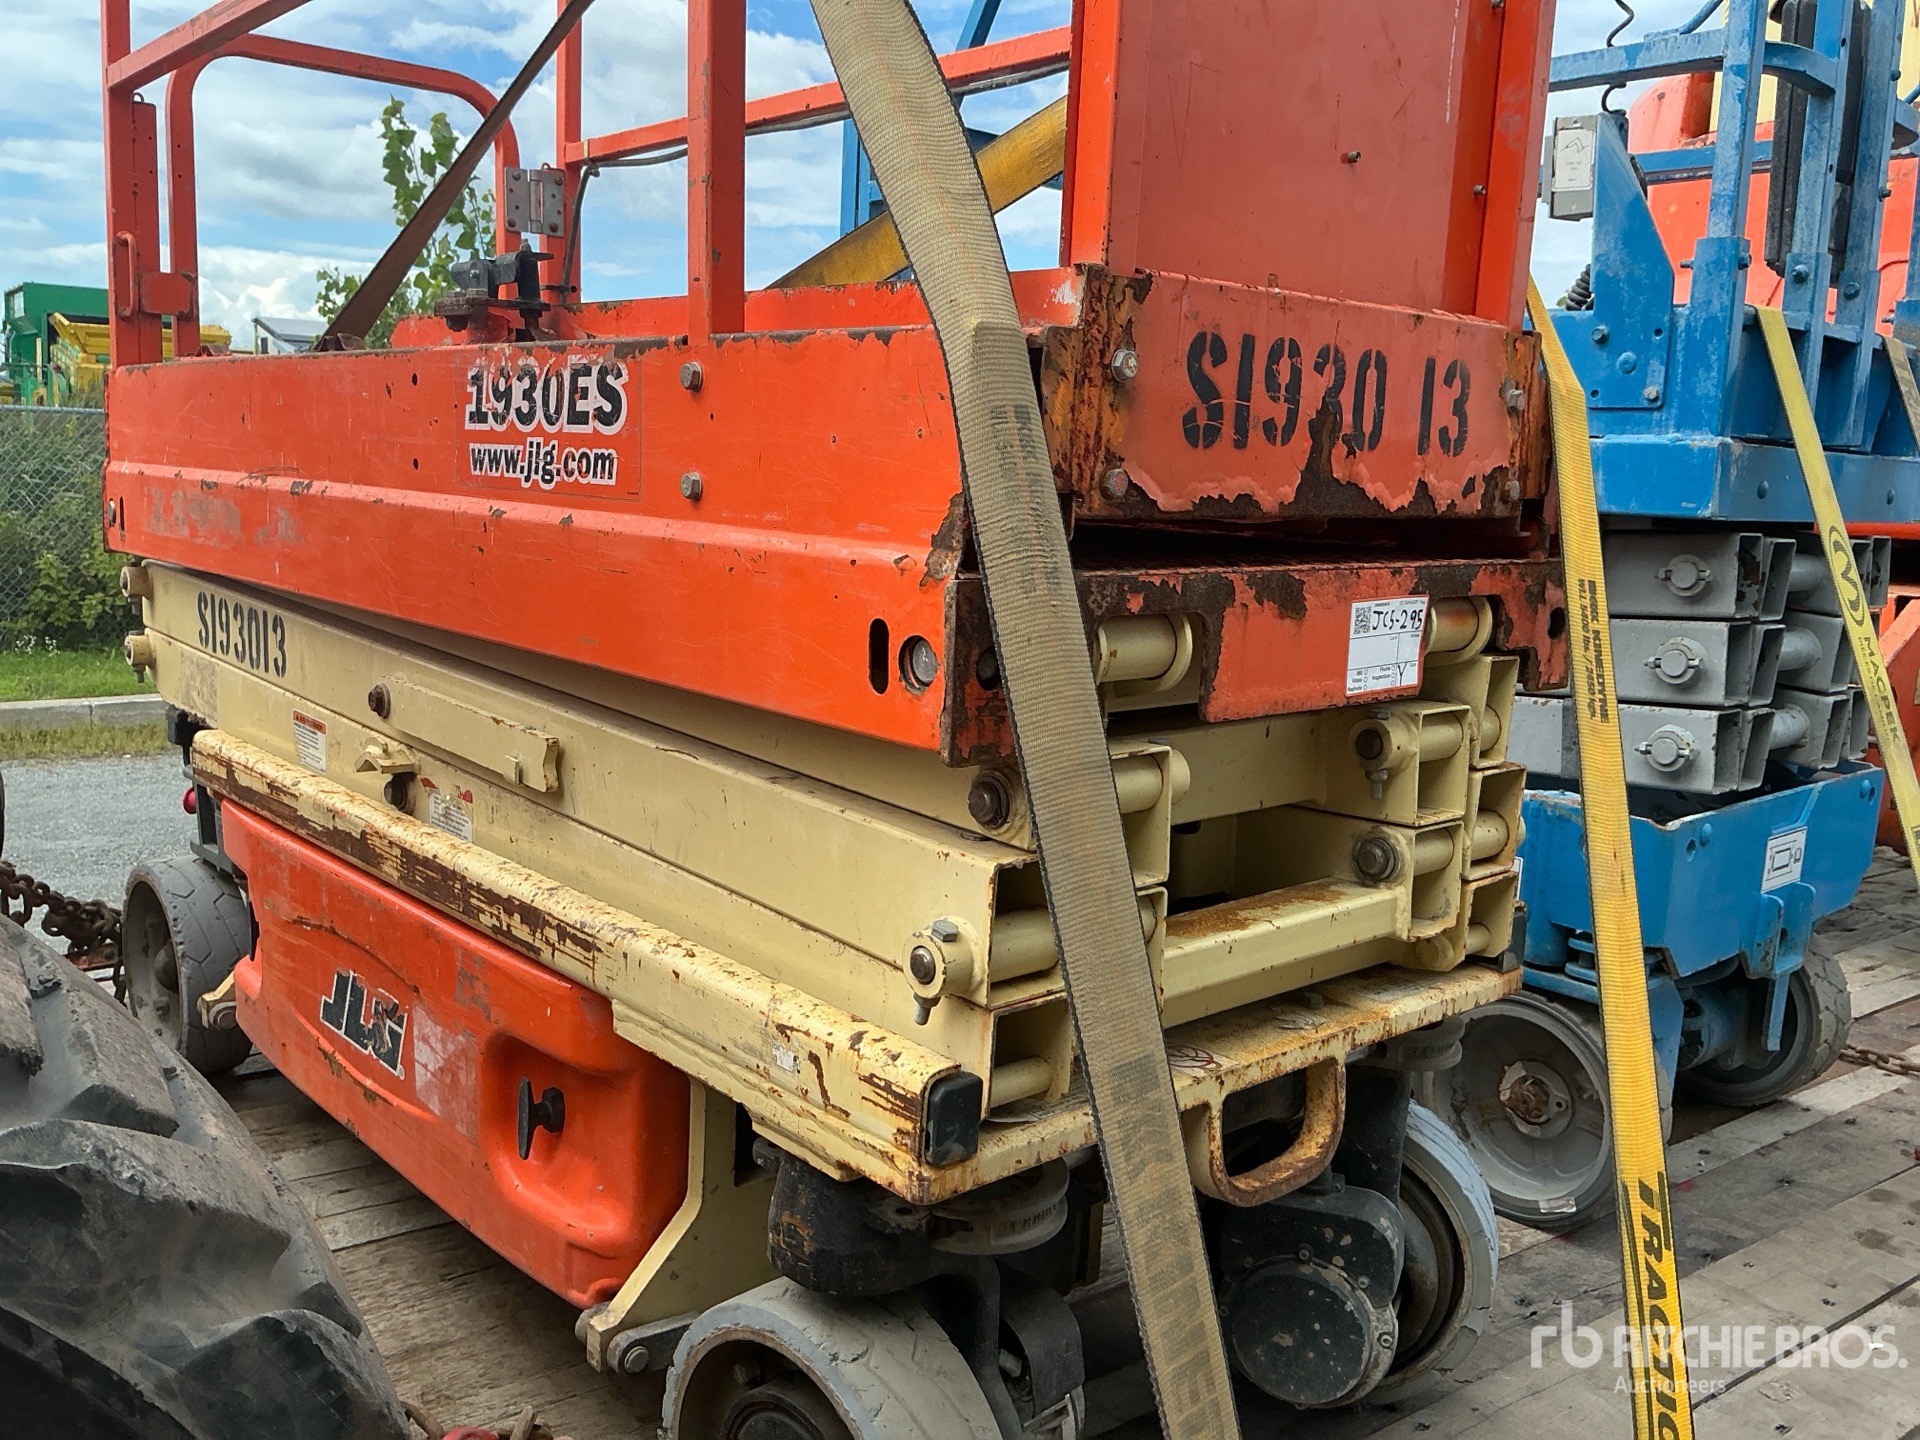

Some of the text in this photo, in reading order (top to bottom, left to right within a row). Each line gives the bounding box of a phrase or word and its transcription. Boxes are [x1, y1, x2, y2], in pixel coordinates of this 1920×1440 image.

[466, 361, 626, 432] 1930ES
[1417, 356, 1470, 457] 13
[469, 438, 618, 487] www.jlg.com
[197, 591, 287, 678] S193013
[1592, 630, 1609, 723] KINEDYNE
[1863, 636, 1901, 743] MACPEK
[320, 970, 406, 1076] JLG
